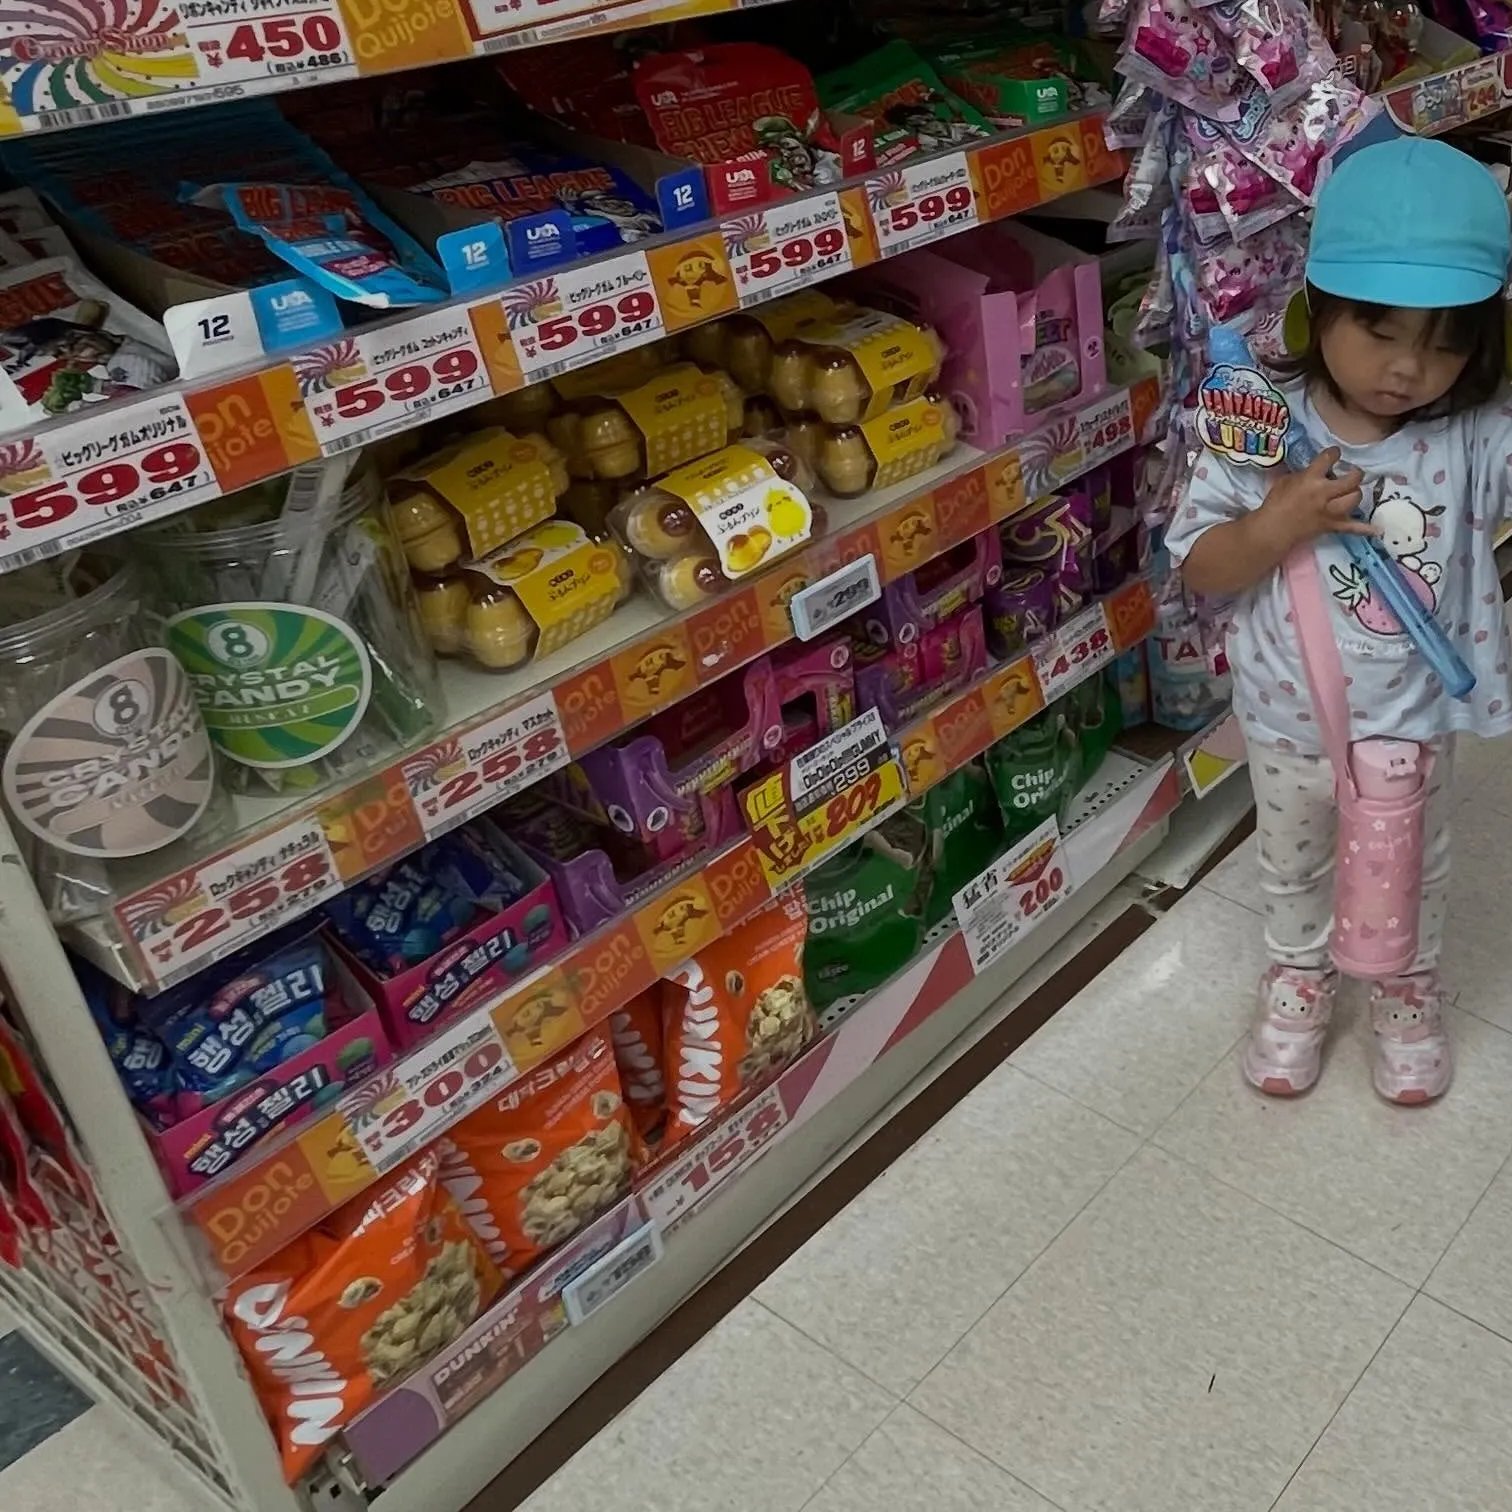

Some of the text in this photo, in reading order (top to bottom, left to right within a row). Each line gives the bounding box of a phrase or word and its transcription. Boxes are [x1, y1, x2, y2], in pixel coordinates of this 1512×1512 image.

[226, 15, 341, 62] 450
[355, 0, 456, 61] Quijote
[650, 90, 679, 107] USA
[1036, 85, 1060, 101] USA
[852, 138, 866, 157] 12
[983, 149, 1029, 186] Don
[672, 184, 695, 207] 12
[725, 169, 755, 185] USA
[890, 186, 972, 232] 599
[461, 240, 489, 266] 12
[525, 223, 561, 243] USA
[750, 228, 844, 278] 599
[270, 292, 313, 312] USA
[537, 291, 655, 351] 599
[198, 315, 231, 339] 12
[334, 349, 479, 419] 599
[196, 388, 253, 440] on
[1202, 388, 1290, 430] FANTASTIC
[11, 443, 201, 529] 599
[935, 474, 980, 518] Don
[220, 625, 247, 656] 8
[698, 603, 752, 652] Don
[190, 654, 341, 689] RYSTAL
[1050, 624, 1110, 679] 438
[108, 683, 140, 725] 8
[560, 672, 604, 710] on
[938, 703, 981, 743] Don
[438, 727, 561, 809] 258
[832, 757, 871, 792] 299
[1010, 765, 1056, 792] Chip
[172, 852, 330, 953] 258
[806, 885, 857, 917] Chip
[807, 885, 896, 937] Original
[1019, 867, 1064, 917] 200
[576, 931, 634, 996] Don
[383, 1043, 503, 1138] 300
[679, 1106, 783, 1192] 158
[208, 1152, 295, 1244] Don
[220, 1169, 315, 1266] Quijote
[432, 1307, 520, 1386] DUNKIN'
